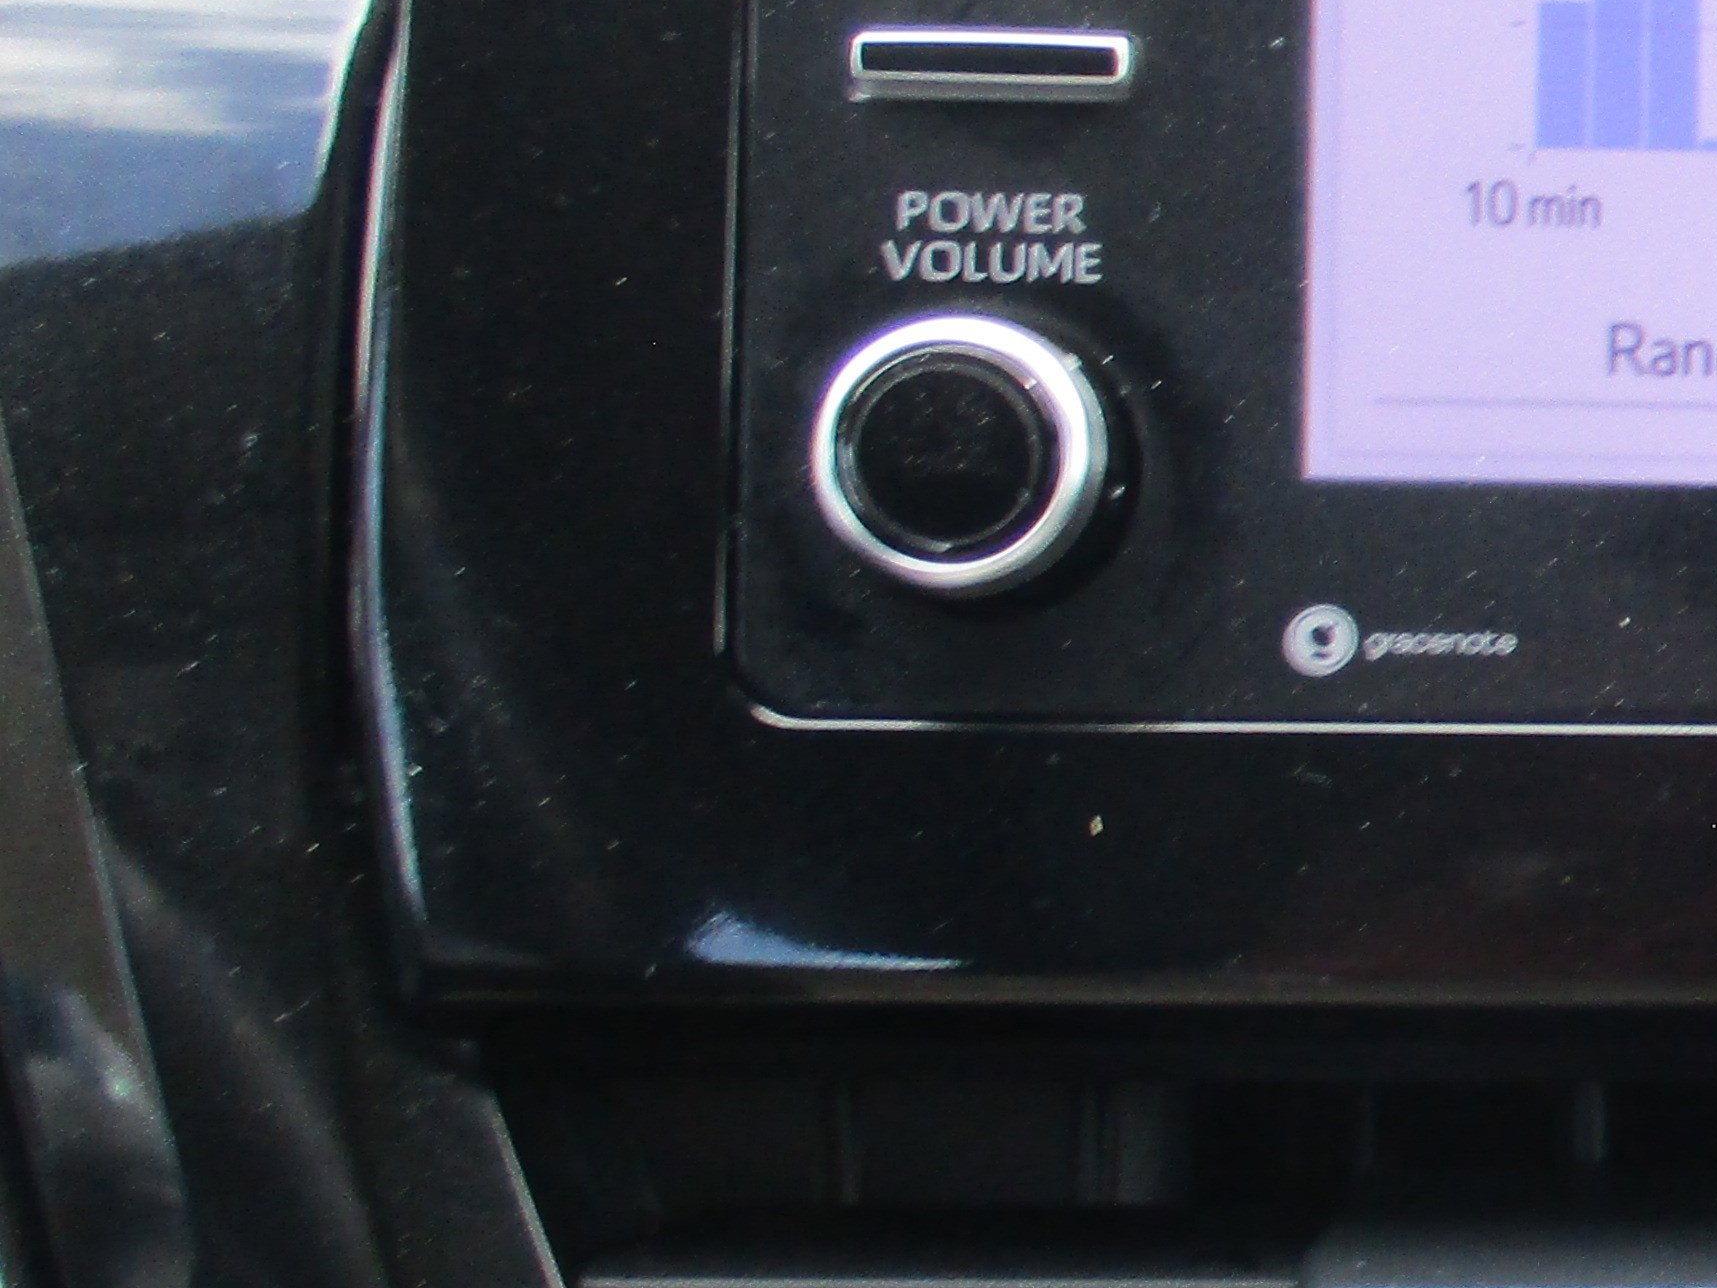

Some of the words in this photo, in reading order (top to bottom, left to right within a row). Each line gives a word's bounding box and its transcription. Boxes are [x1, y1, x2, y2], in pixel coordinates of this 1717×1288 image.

[895, 189, 1087, 235] POWER
[1464, 179, 1519, 228] 10
[1528, 187, 1602, 230] min
[880, 238, 1103, 285] VOLUME
